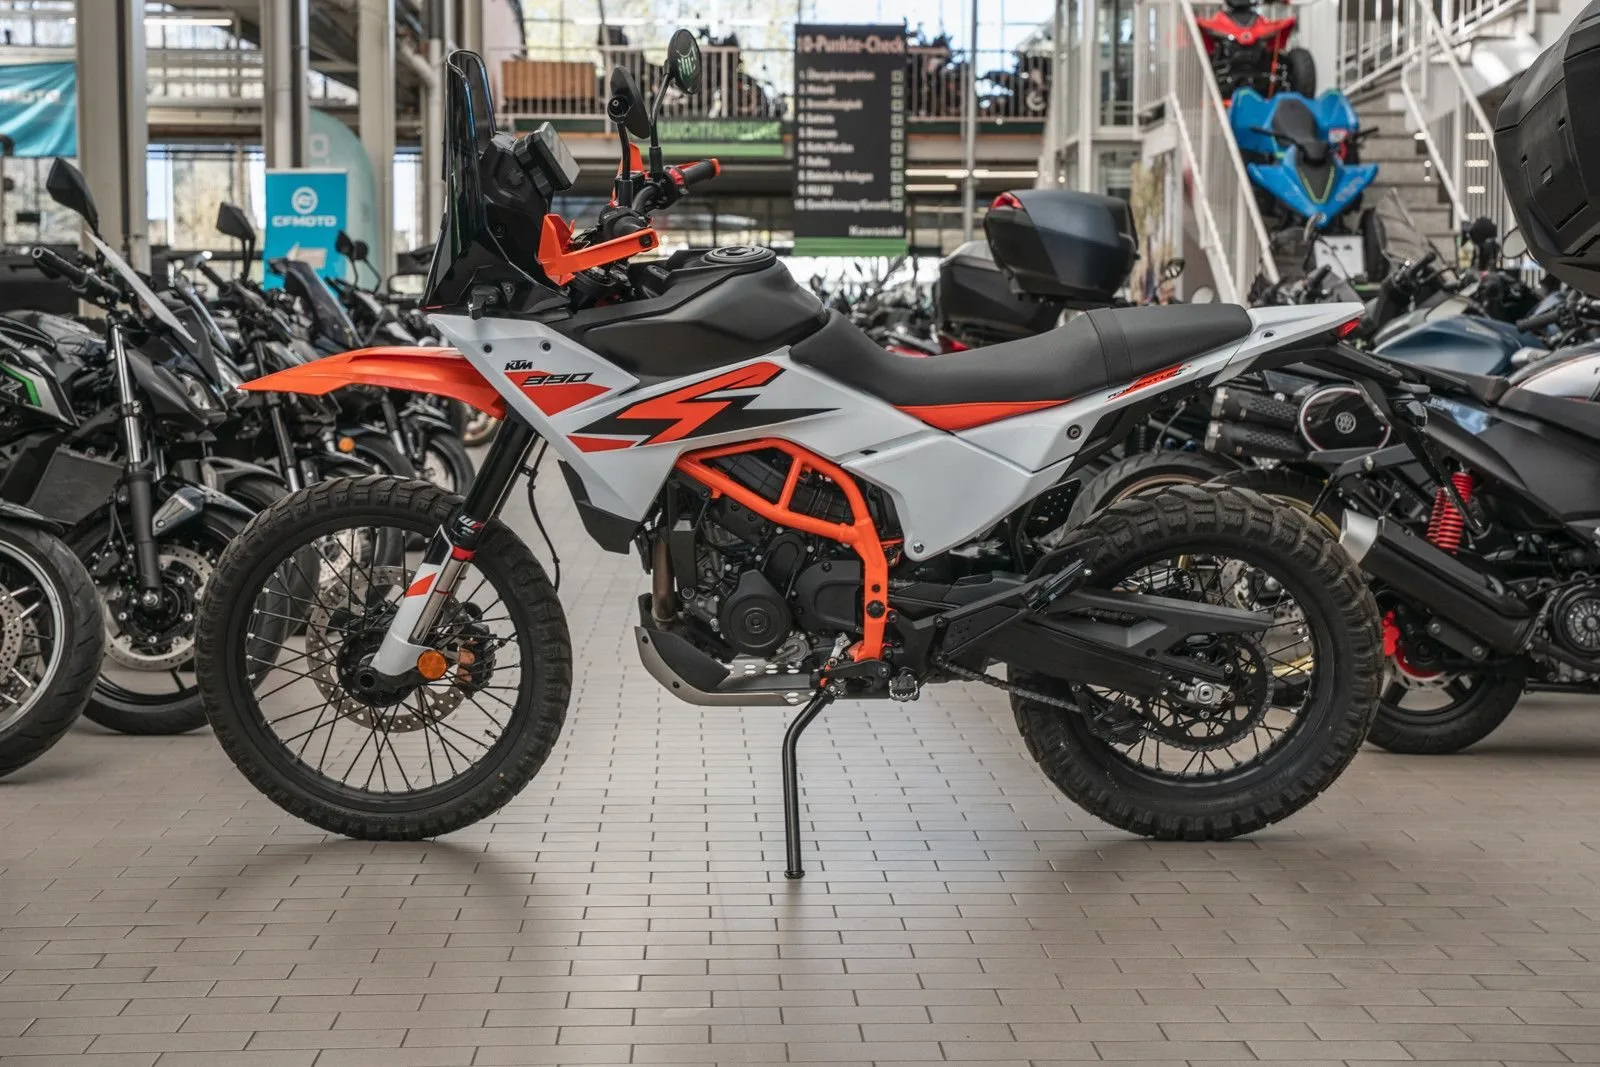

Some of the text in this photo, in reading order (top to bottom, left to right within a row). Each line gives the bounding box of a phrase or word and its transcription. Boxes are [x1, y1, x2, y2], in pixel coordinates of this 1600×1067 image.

[797, 34, 905, 54] 10-Punkte-Check
[271, 214, 337, 227] CFMOTO
[849, 225, 904, 237] Kawasaki
[504, 359, 533, 371] KTM
